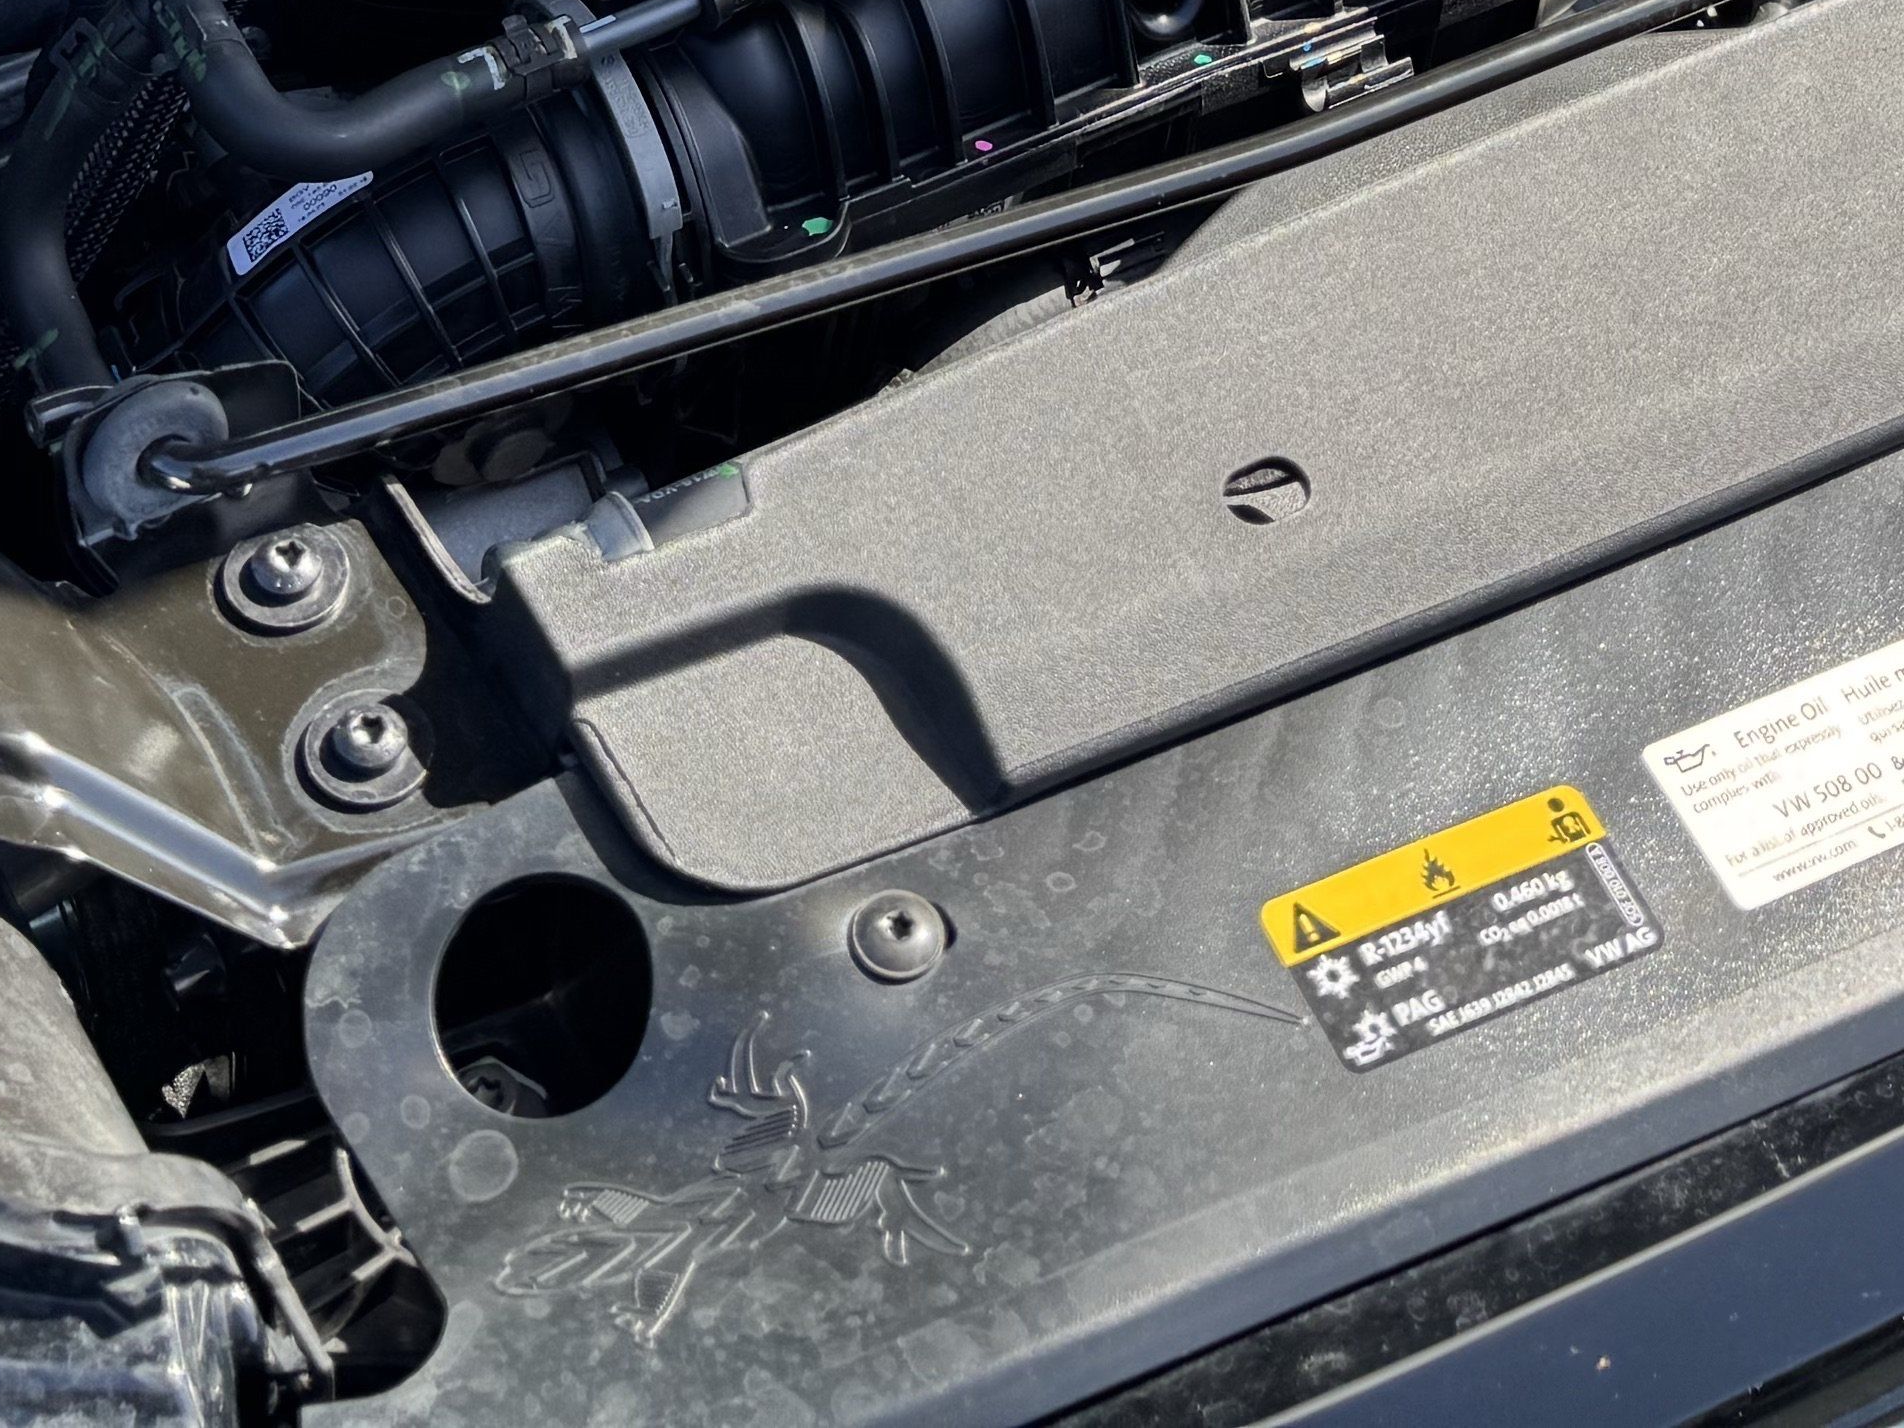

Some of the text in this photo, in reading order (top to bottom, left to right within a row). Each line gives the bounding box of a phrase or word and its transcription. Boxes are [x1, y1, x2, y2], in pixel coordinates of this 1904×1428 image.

[1732, 705, 1803, 757] Engine
[1798, 694, 1830, 722] Oil
[1839, 667, 1893, 707] Huile
[1771, 788, 1813, 822] VW
[1813, 771, 1854, 804] 508
[1852, 758, 1884, 787] 00
[1356, 865, 1576, 970] R-1234yf 0.460 kg
[1582, 923, 1659, 971] VW AG
[1388, 986, 1449, 1029] PAG
[1425, 1011, 1459, 1036] SAE
